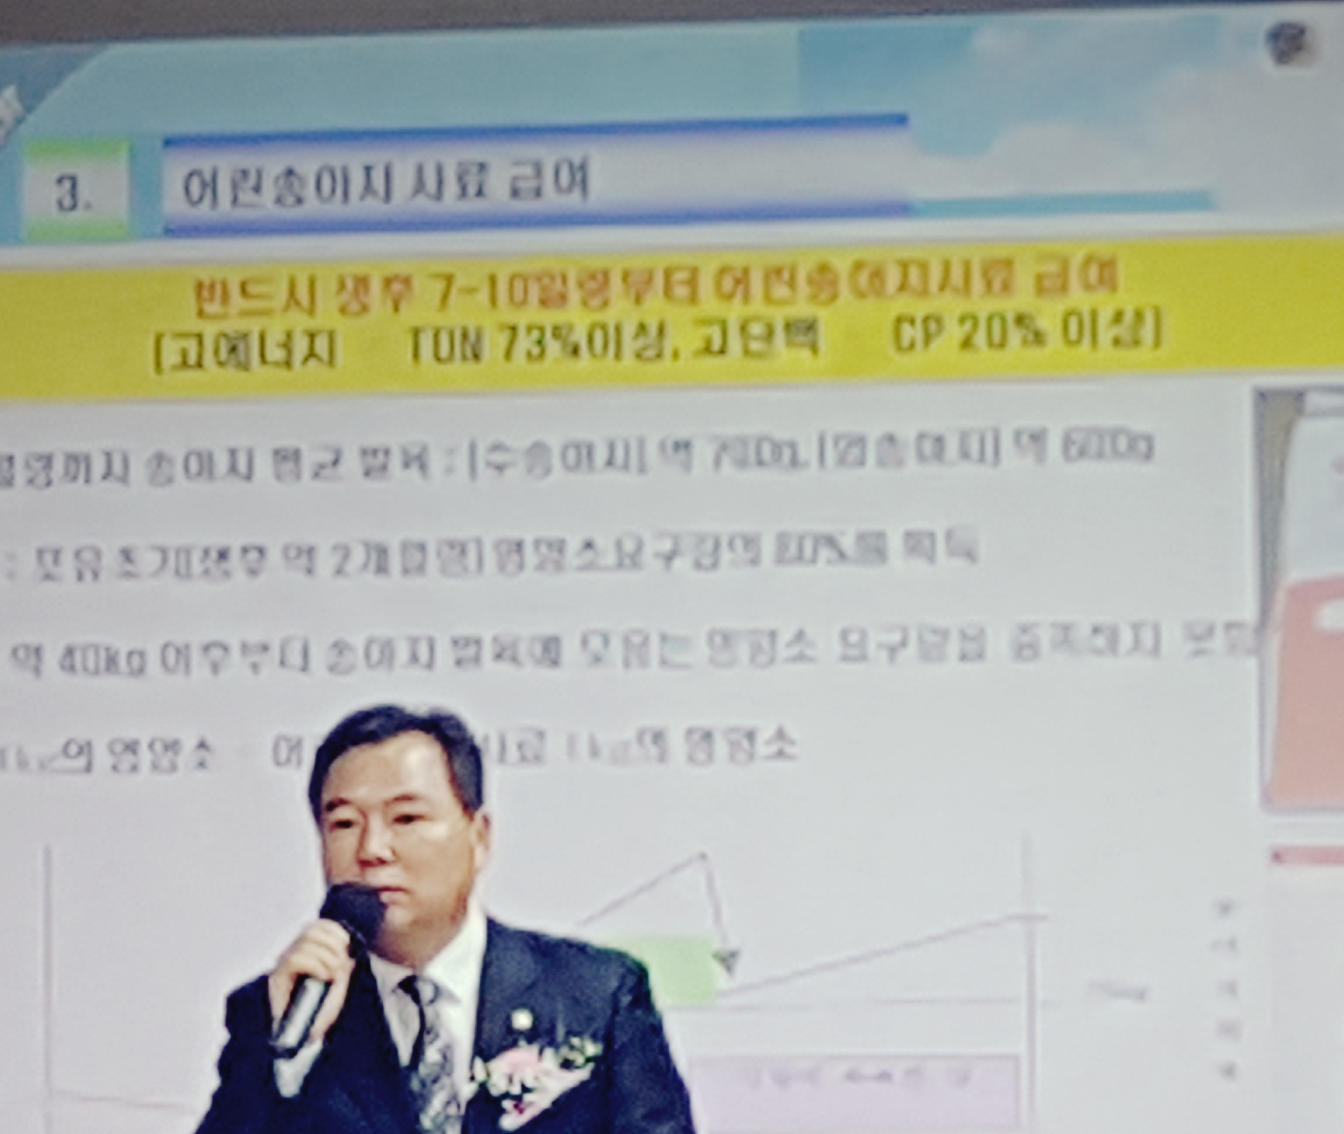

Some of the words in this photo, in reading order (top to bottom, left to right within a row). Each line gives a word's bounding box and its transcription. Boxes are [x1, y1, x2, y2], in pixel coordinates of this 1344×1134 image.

[56, 174, 92, 211] 3.
[184, 162, 392, 209] 어린송아지
[410, 160, 488, 203] 사료
[508, 154, 589, 201] 급여
[195, 274, 316, 319] 반드시
[336, 273, 414, 317] 생후
[1035, 253, 1118, 298] 급여
[894, 312, 944, 351] CP
[958, 312, 1046, 350] 20%
[145, 447, 253, 488] 송아지
[325, 634, 435, 675] 송아지
